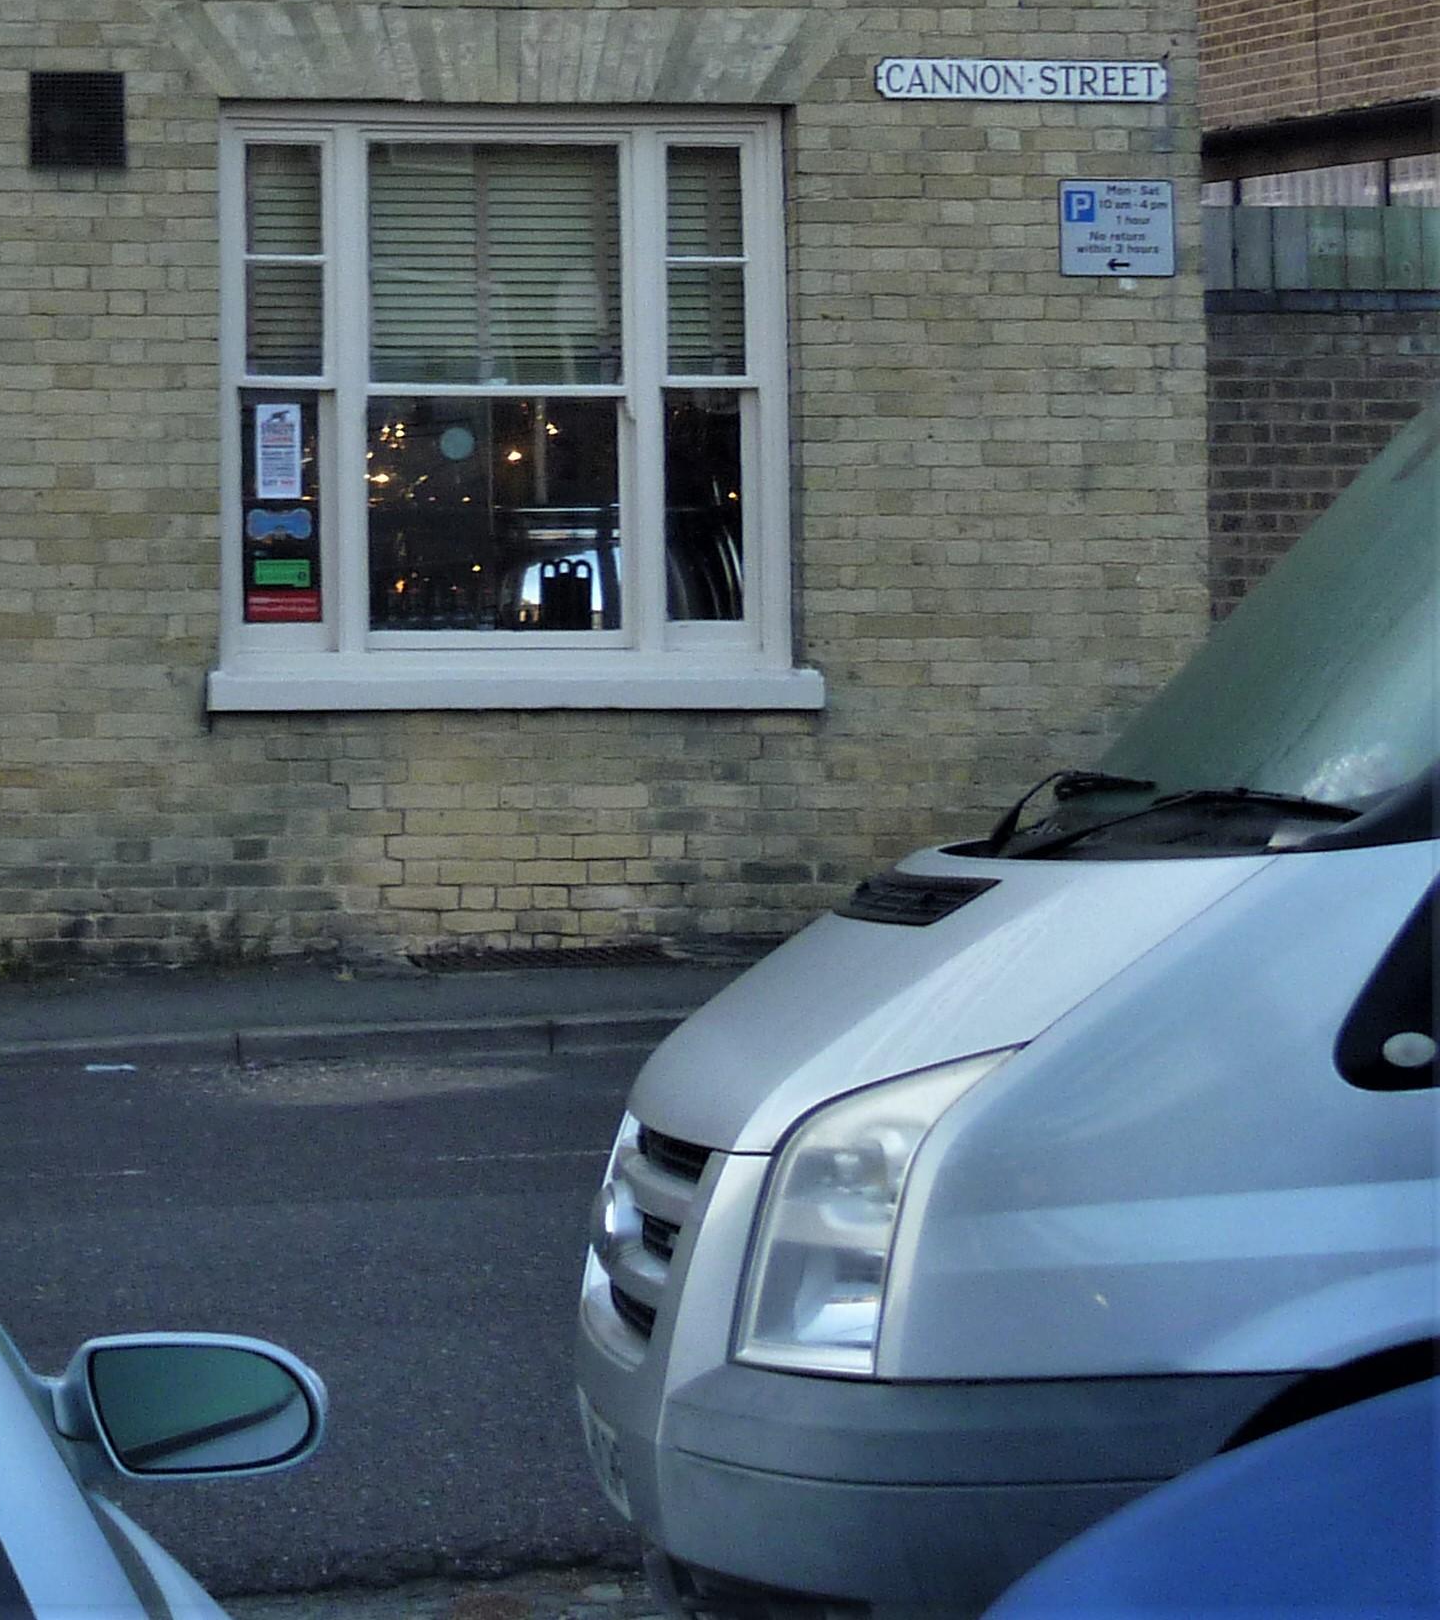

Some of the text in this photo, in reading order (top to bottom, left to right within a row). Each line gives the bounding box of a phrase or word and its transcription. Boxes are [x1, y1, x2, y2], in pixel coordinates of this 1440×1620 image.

[885, 63, 1160, 97] CANNON STREET
[1106, 185, 1132, 196] Mon
[1140, 185, 1160, 196] Sat
[1071, 193, 1092, 220] P
[1125, 215, 1150, 225] hour
[1089, 231, 1145, 241] No return
[1077, 244, 1112, 254] within
[1126, 244, 1159, 254] hours
